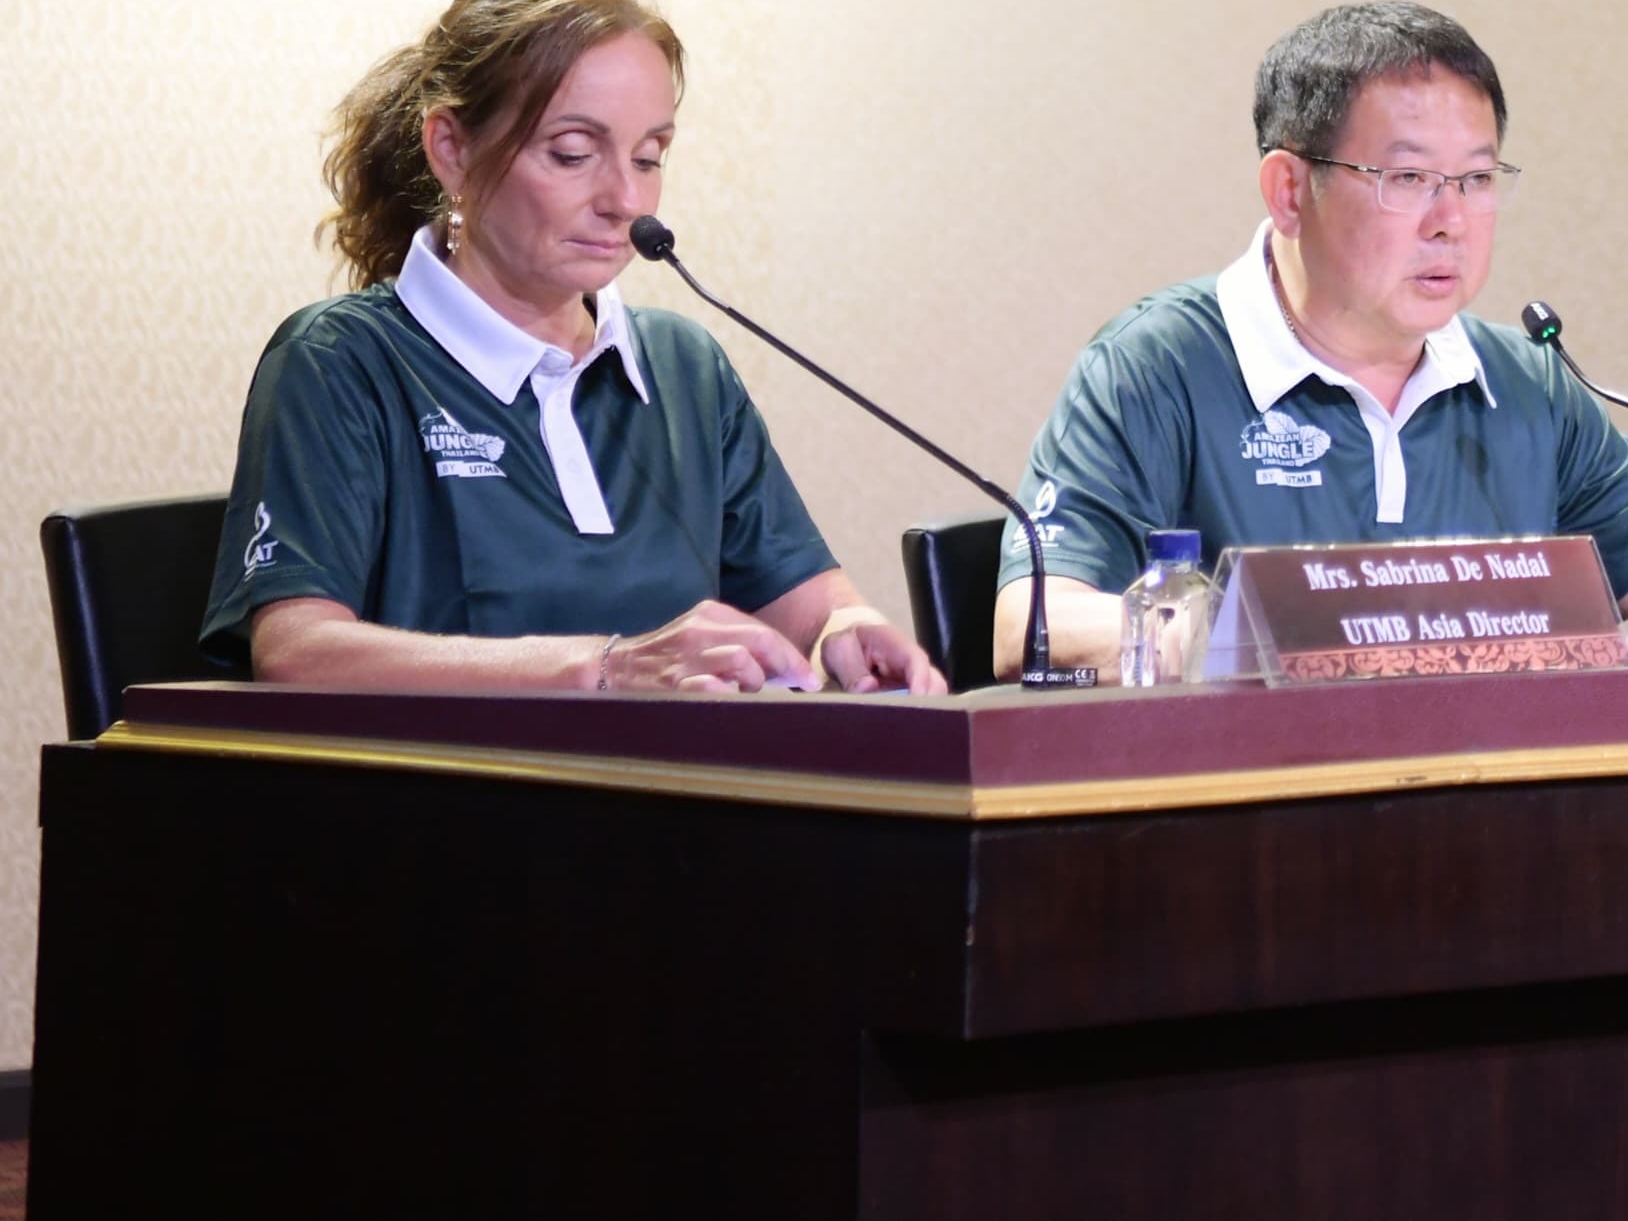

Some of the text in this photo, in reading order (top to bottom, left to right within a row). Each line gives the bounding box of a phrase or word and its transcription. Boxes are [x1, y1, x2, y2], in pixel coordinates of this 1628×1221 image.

[1242, 440, 1313, 459] JUNGLE
[1303, 551, 1552, 590] Mrs. Sabrina De Nadai
[1340, 610, 1551, 645] UTMB Asia Director
[1022, 672, 1044, 682] AKG
